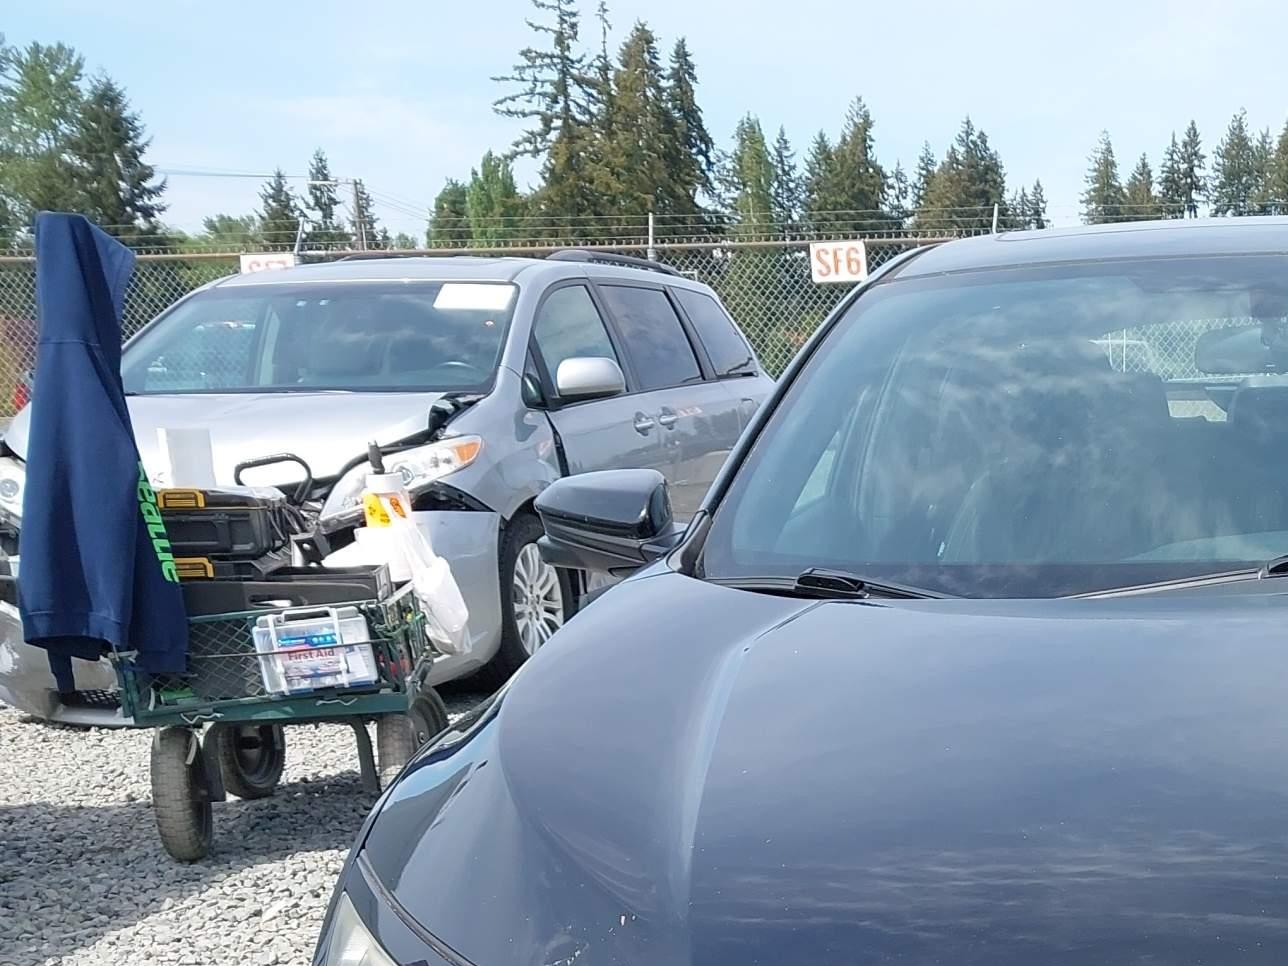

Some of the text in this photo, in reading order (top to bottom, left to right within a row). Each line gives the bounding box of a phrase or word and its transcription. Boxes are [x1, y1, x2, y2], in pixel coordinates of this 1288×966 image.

[816, 247, 861, 277] SF6
[288, 648, 335, 661] First Aid
